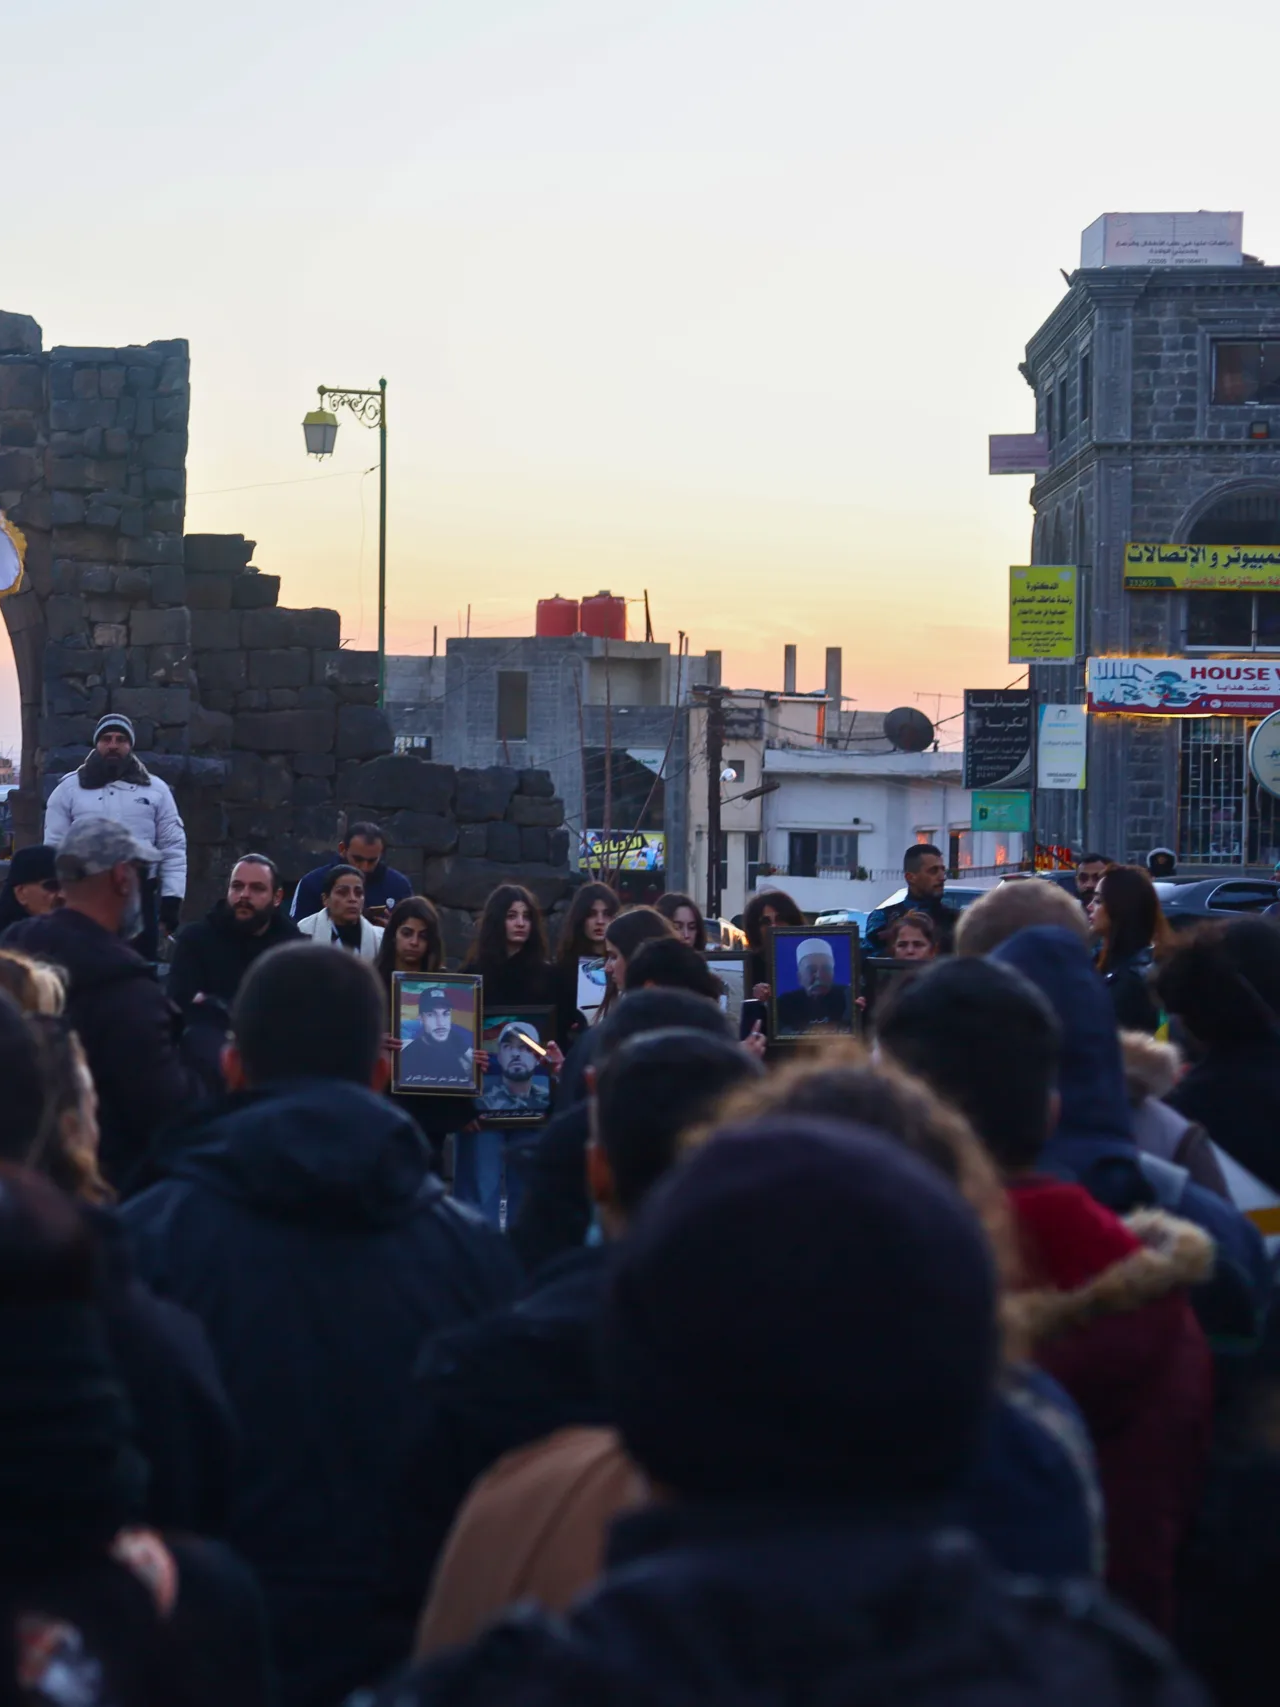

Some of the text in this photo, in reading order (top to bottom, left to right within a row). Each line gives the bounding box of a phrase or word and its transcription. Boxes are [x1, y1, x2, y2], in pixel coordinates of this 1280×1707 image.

[1128, 545, 1206, 567] الإتصالات
[1221, 547, 1280, 569] مبيوتر
[1191, 667, 1270, 680] HOUSE
